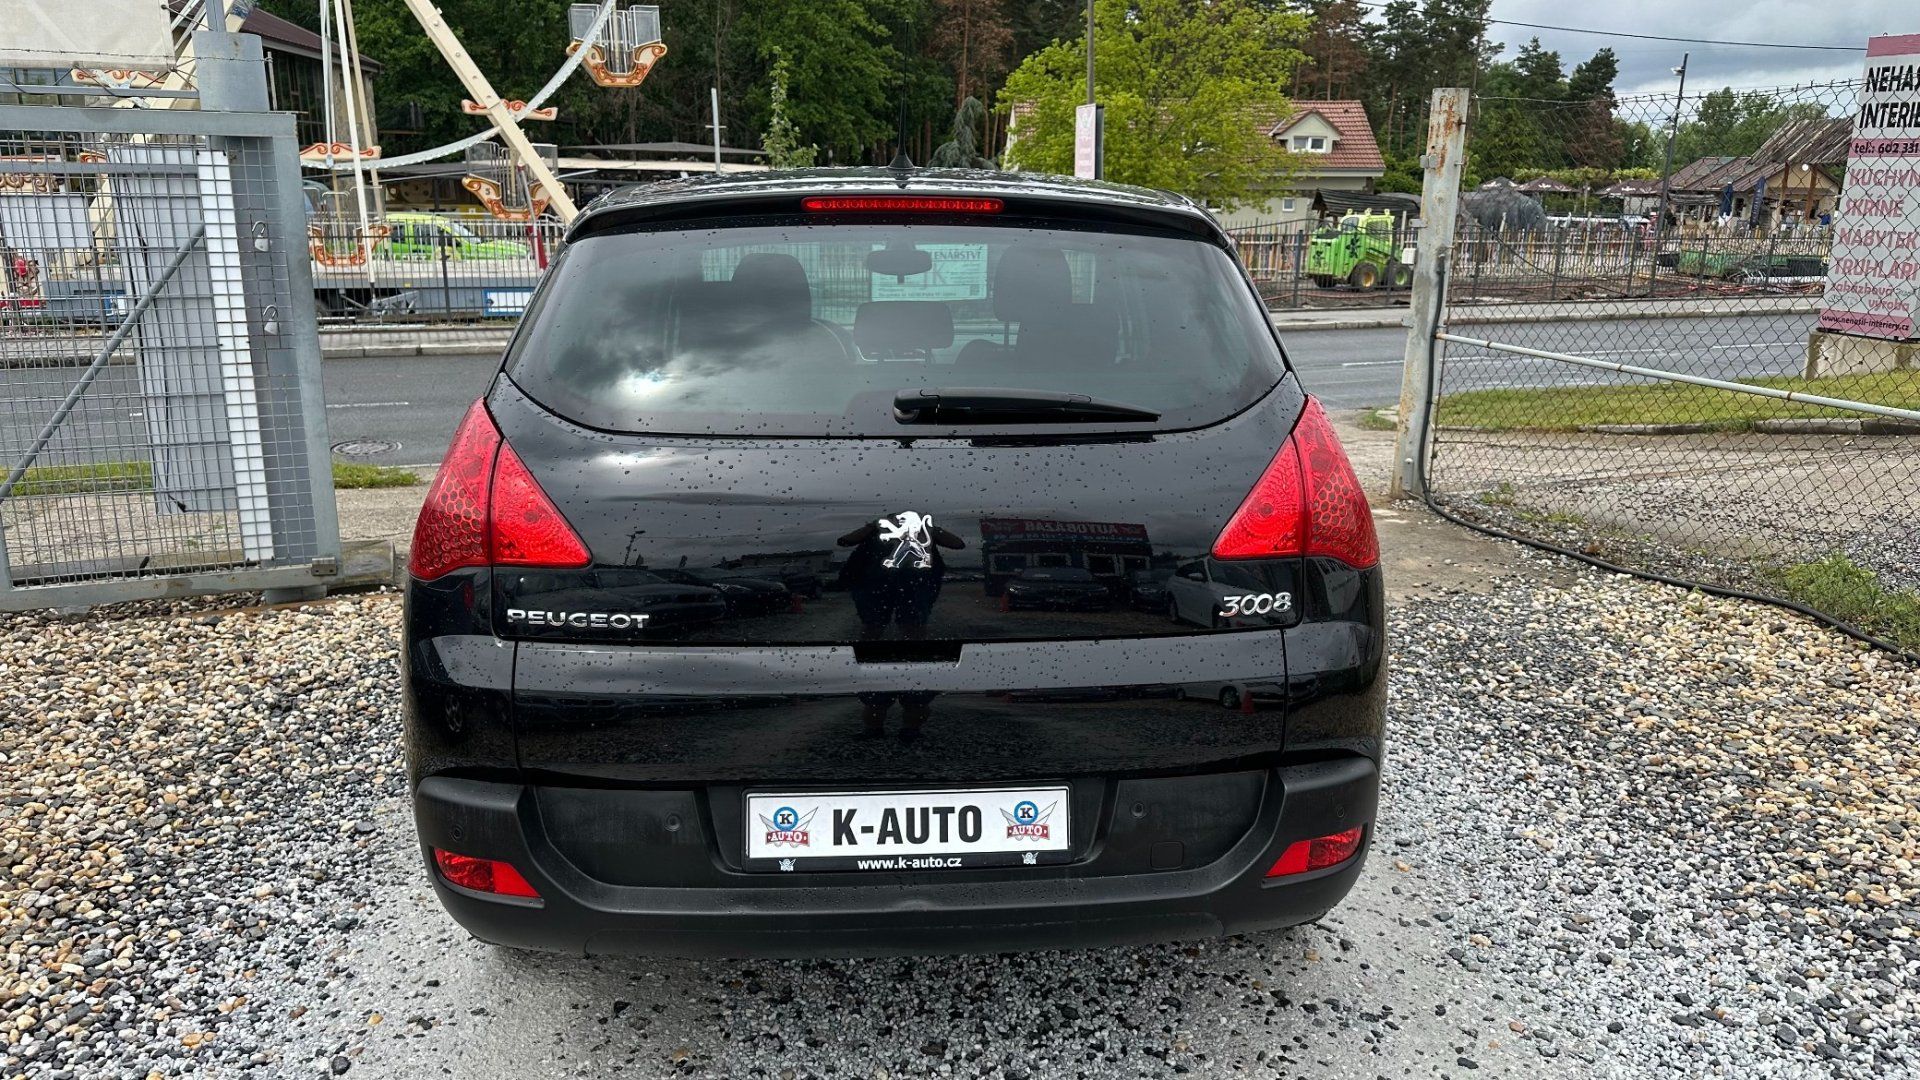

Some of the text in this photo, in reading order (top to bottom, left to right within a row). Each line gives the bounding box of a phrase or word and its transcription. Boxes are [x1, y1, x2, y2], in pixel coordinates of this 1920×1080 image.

[1878, 142, 1899, 154] 602
[1901, 142, 1919, 154] 331
[1840, 223, 1920, 249] NÁBYTEK
[1219, 591, 1292, 617] 3008
[507, 608, 650, 629] PEUGEOT
[779, 813, 793, 825] K
[1019, 807, 1033, 819] K
[832, 804, 982, 846] K-AUTO
[1010, 824, 1045, 836] AUTO
[770, 831, 803, 843] AUTO
[857, 856, 962, 870] www.k-auto.cz
